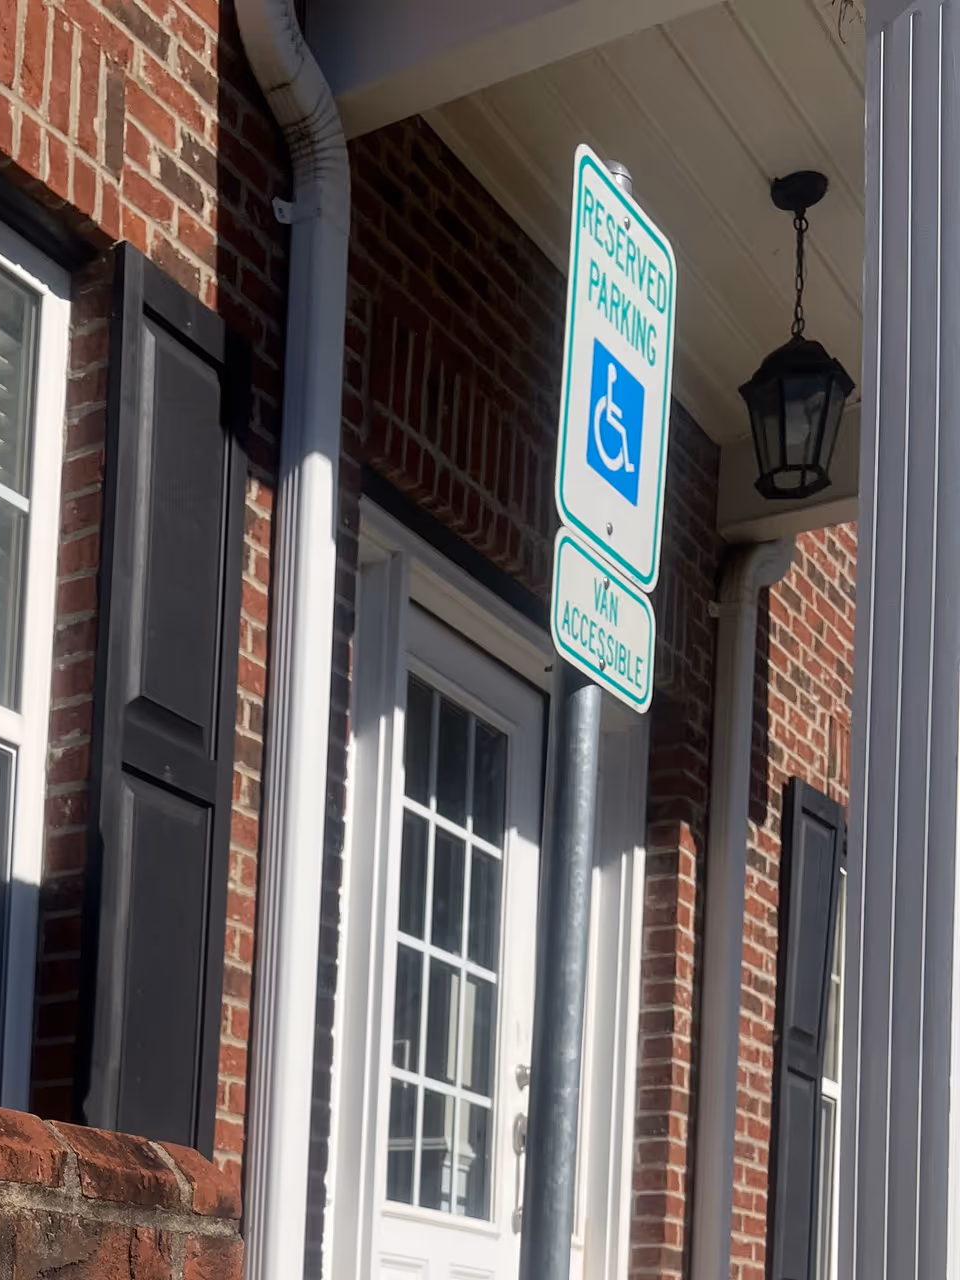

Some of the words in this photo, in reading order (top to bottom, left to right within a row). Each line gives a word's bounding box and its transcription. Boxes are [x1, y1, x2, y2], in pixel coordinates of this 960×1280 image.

[583, 185, 667, 315] RESERVED
[588, 256, 657, 367] PARKING
[562, 601, 643, 689] ACCESSIBLE
[594, 577, 619, 627] VAN
